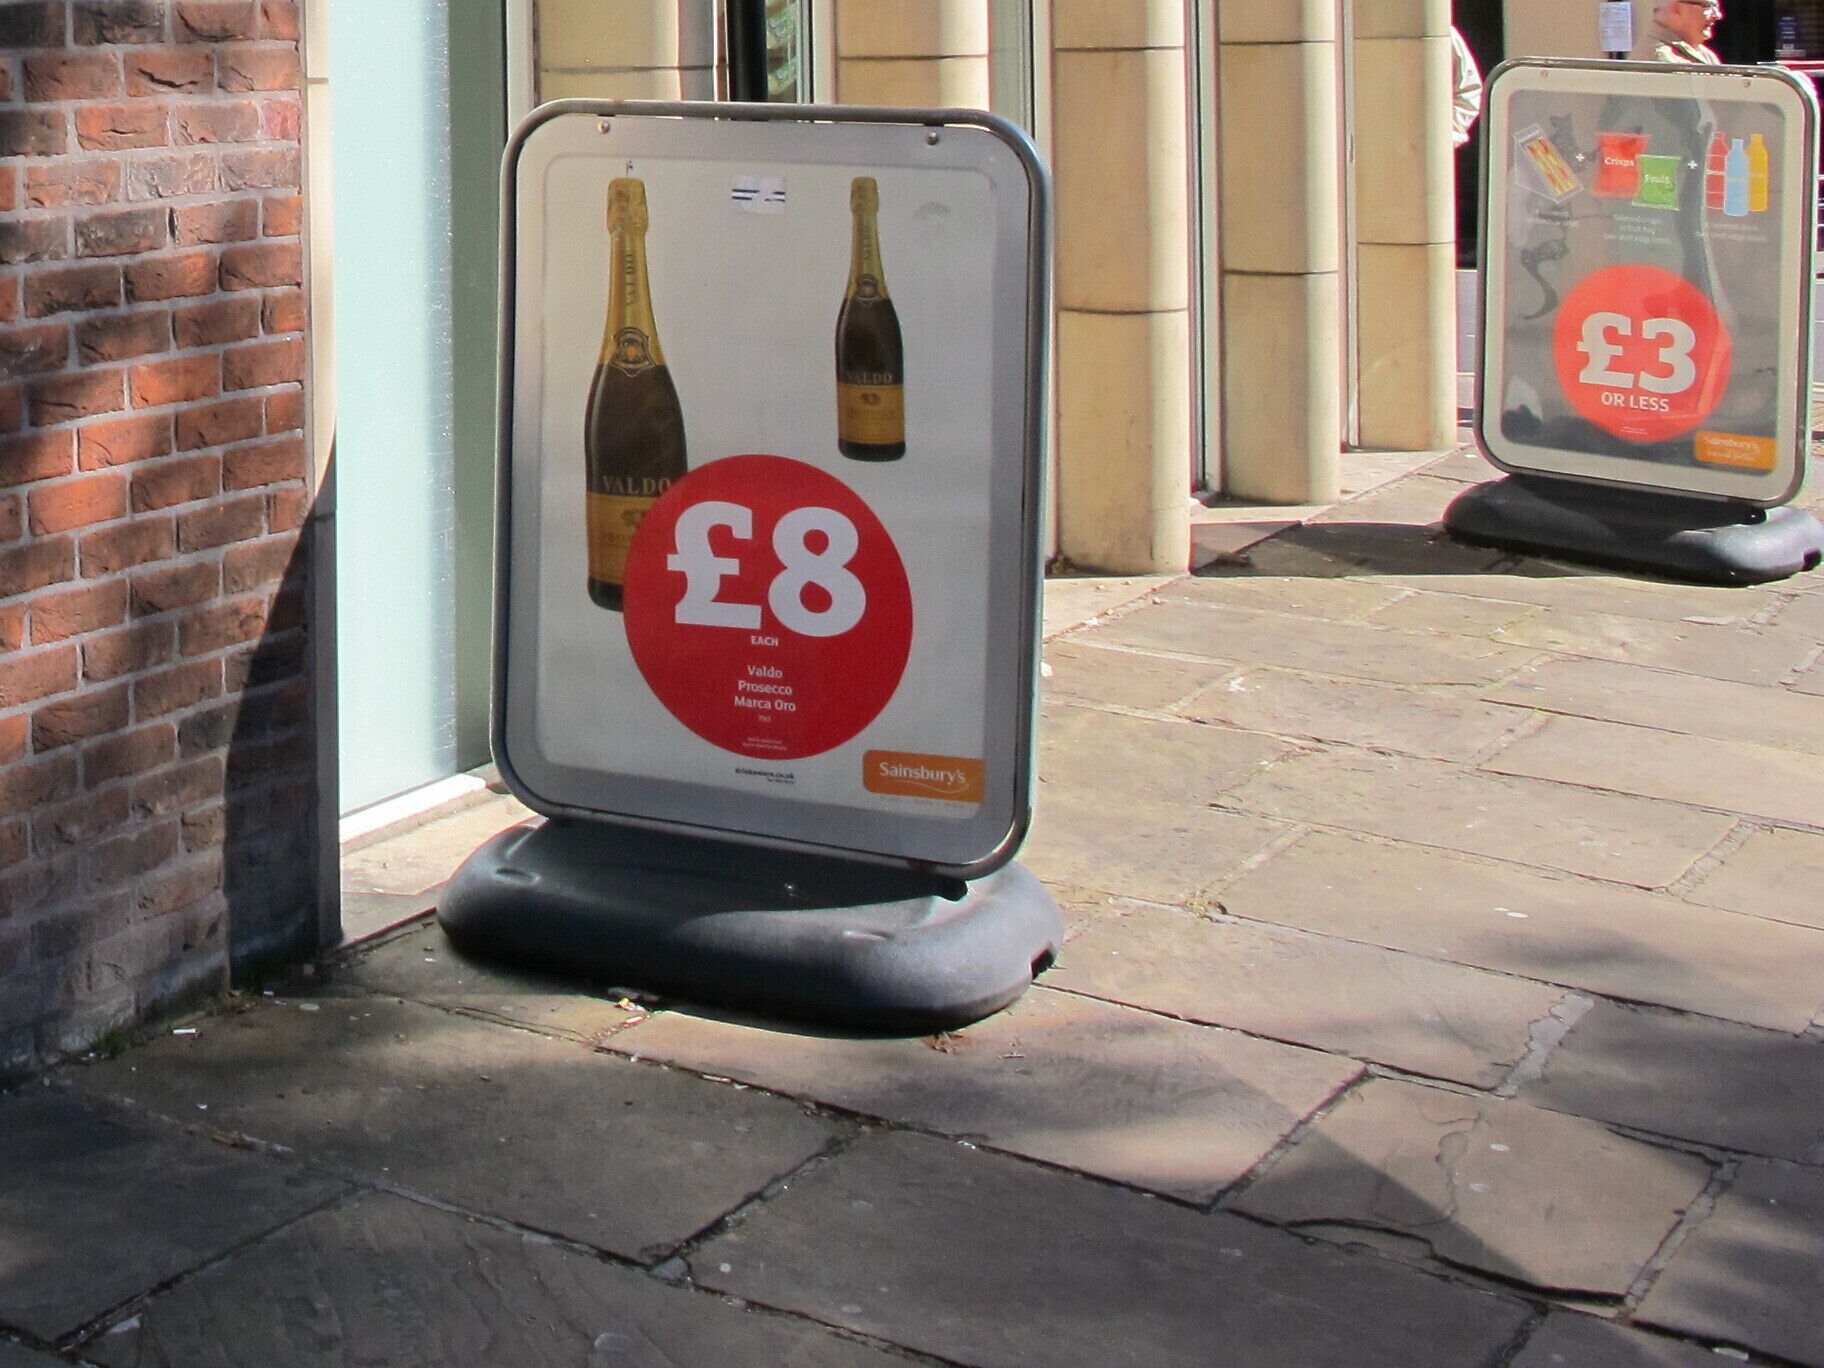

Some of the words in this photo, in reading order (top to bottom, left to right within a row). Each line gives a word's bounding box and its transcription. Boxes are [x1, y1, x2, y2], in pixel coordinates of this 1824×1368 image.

[1603, 156, 1636, 169] Crisps
[1576, 310, 1697, 395] £3
[1601, 395, 1625, 407] OR
[1629, 397, 1670, 412] LESS
[602, 474, 672, 495] VALDO
[667, 501, 866, 637] £8
[750, 635, 780, 647] EACH
[747, 664, 784, 679] Valdo
[737, 680, 794, 696] Prosecco
[734, 696, 772, 710] Marca
[774, 698, 797, 713] Oro
[879, 761, 967, 785] Sainsbury's
